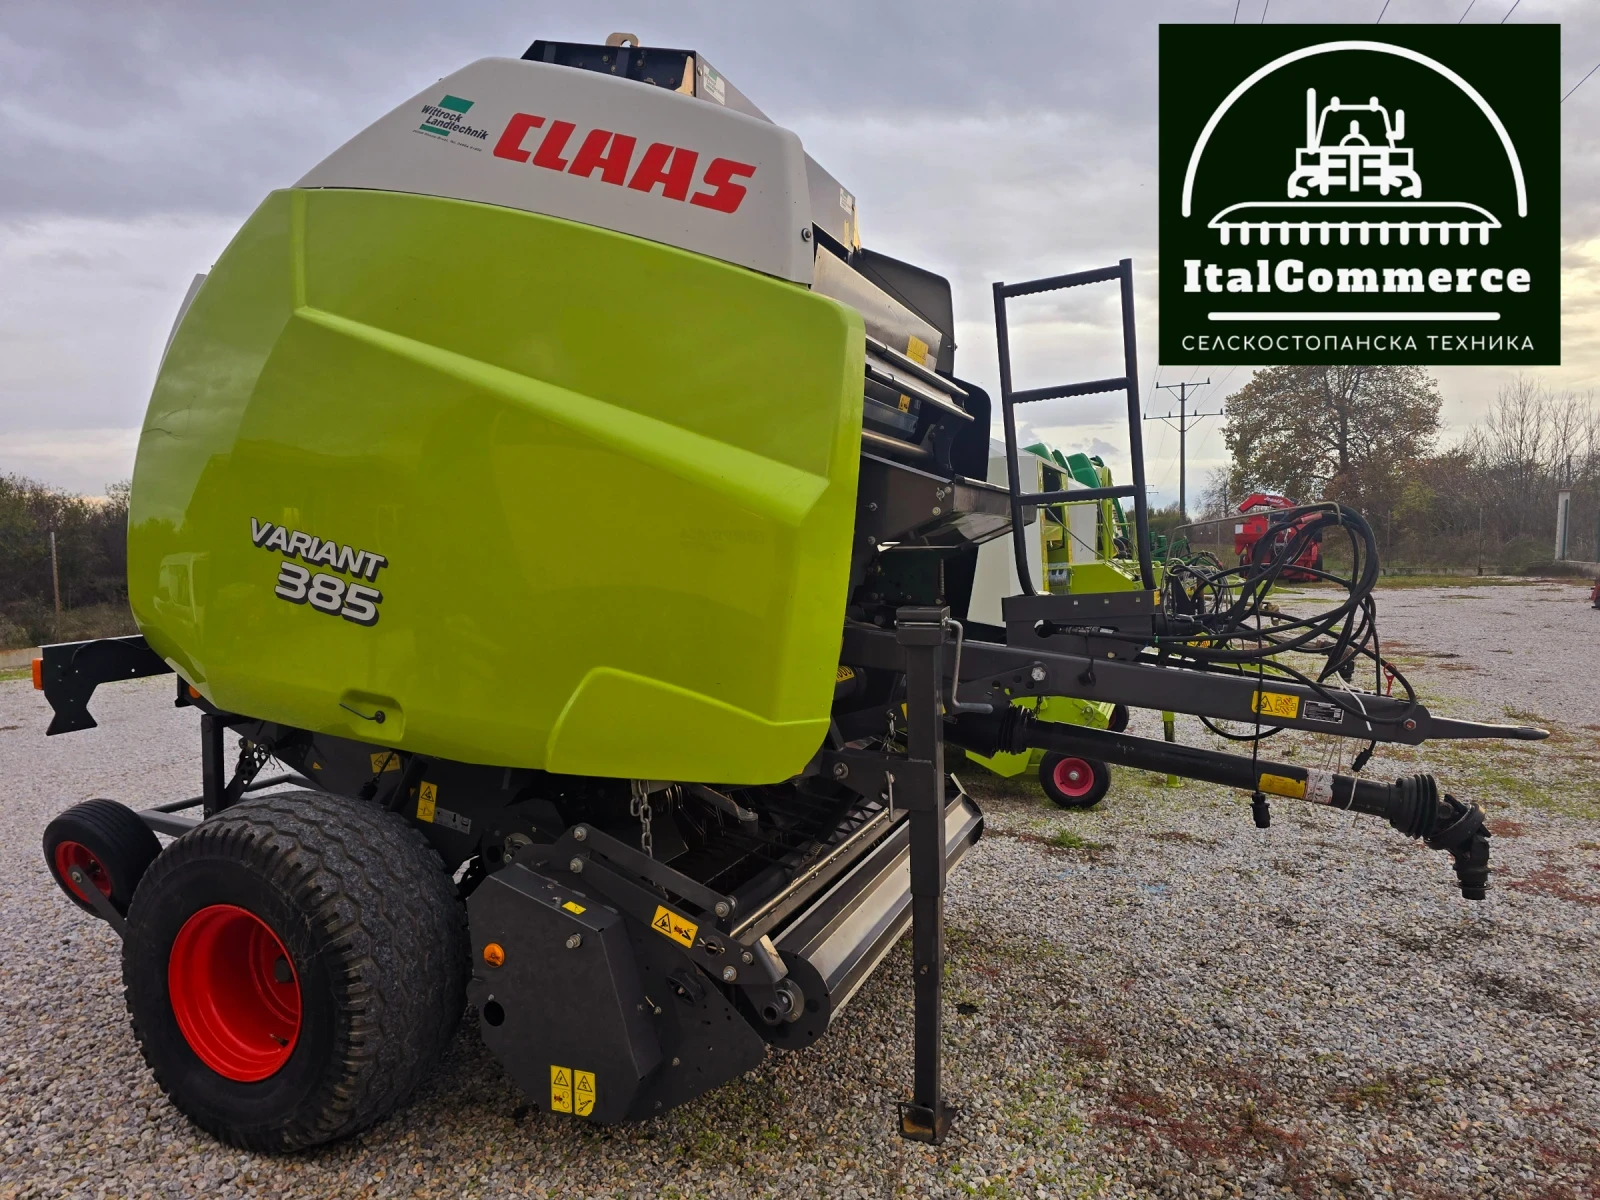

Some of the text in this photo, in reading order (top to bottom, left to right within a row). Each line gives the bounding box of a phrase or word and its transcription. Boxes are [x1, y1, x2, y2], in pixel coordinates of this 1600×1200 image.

[421, 104, 463, 123] Wittrock
[425, 115, 489, 140] Landtechnik
[493, 112, 757, 214] CLAAS
[251, 517, 389, 582] VARIANT
[274, 560, 384, 627] 385
